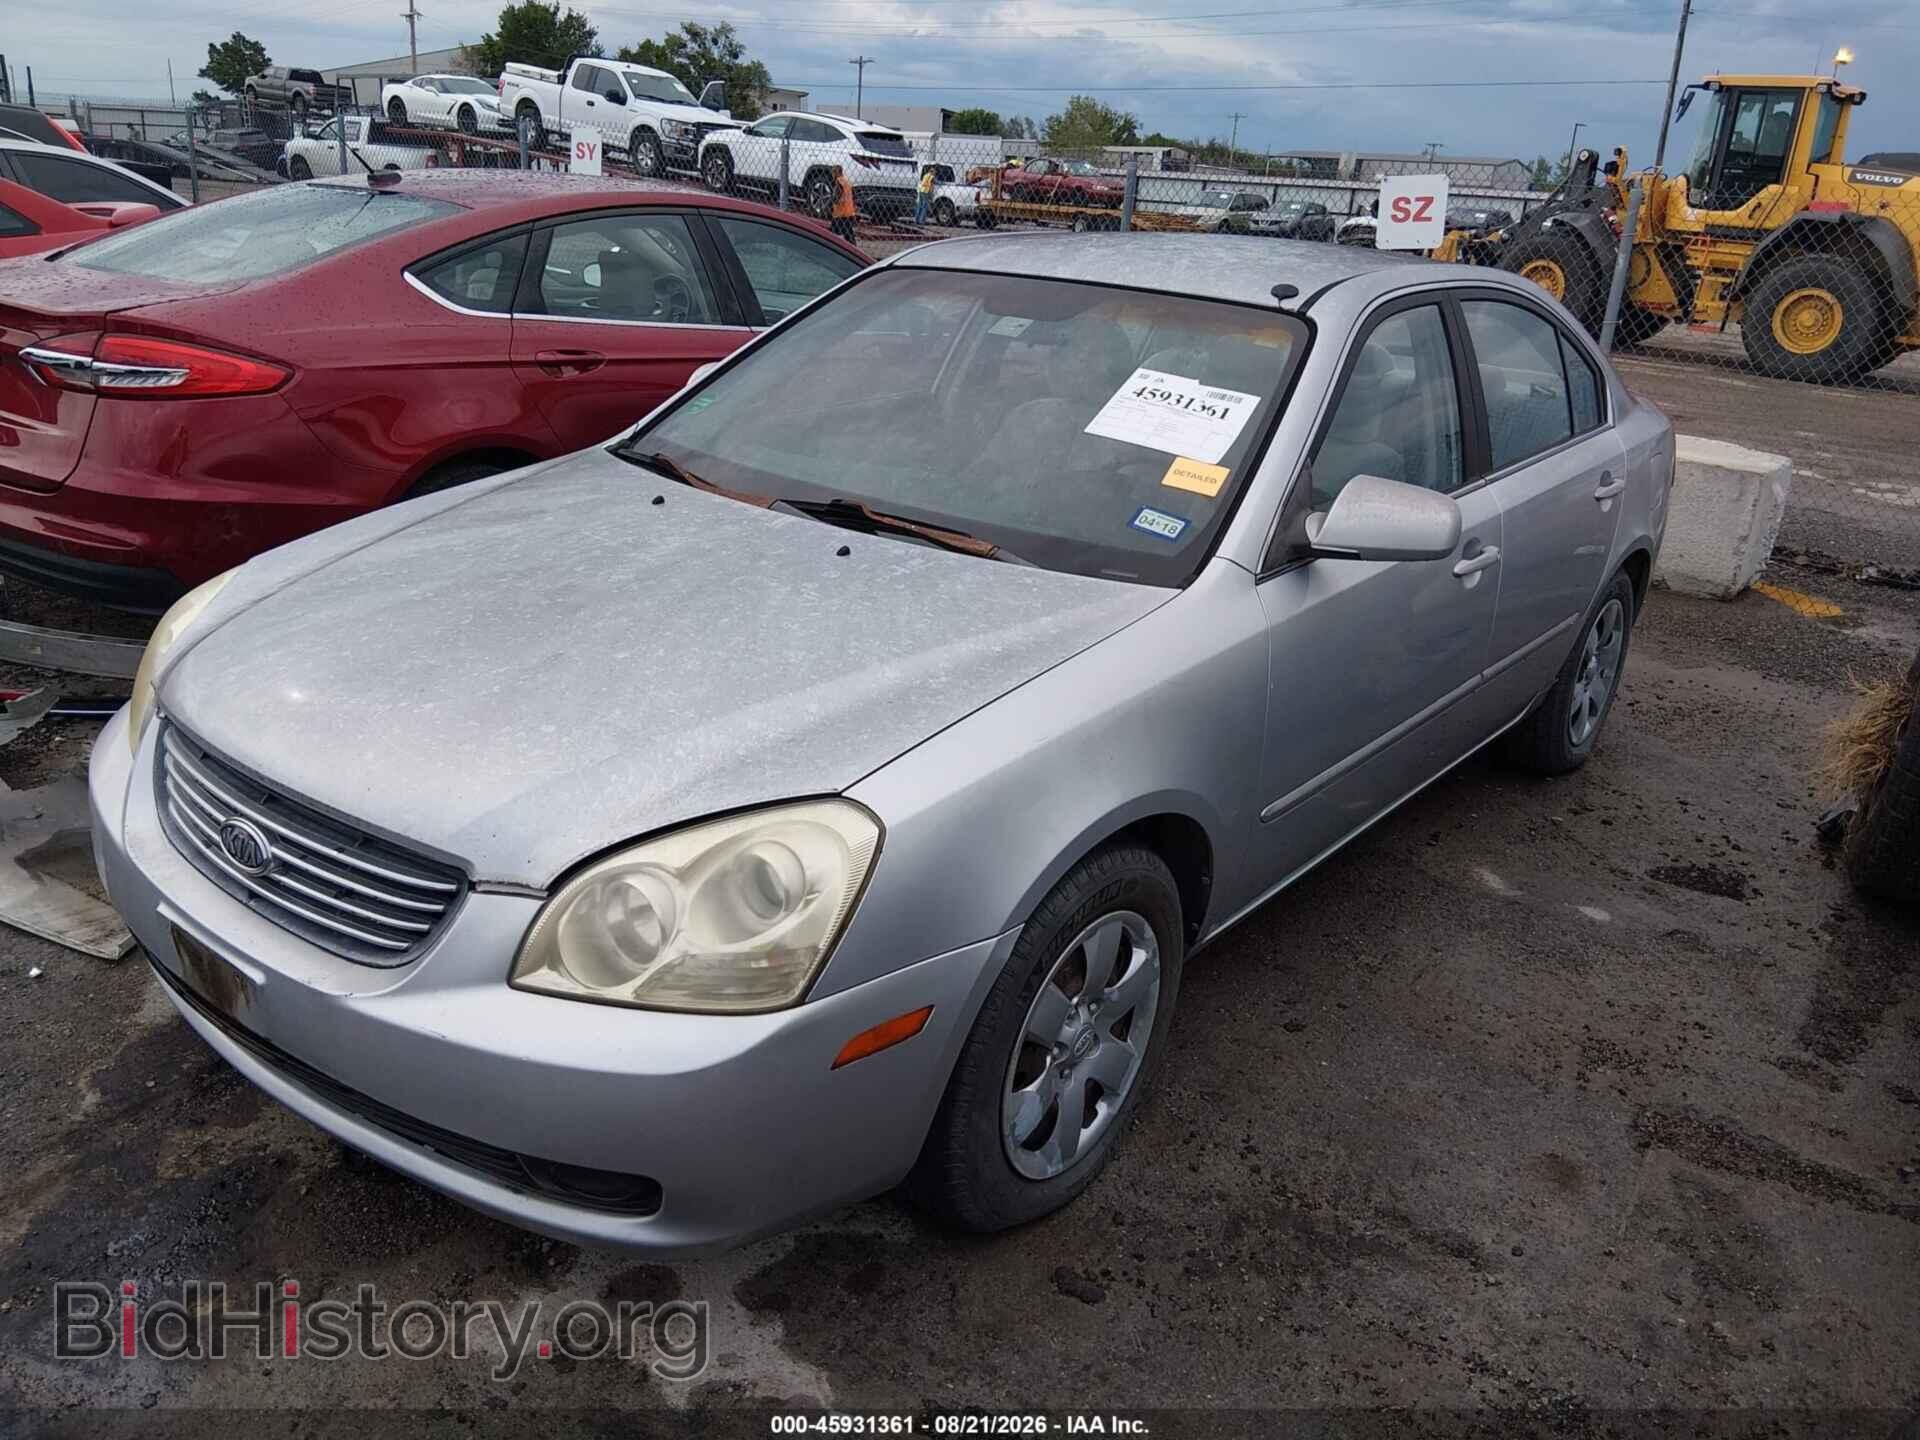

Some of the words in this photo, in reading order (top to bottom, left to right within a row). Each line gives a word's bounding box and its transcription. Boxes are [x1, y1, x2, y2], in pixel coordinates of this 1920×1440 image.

[576, 142, 597, 161] SY
[1855, 173, 1904, 185] VOLVO
[1391, 196, 1435, 223] SZ
[1173, 469, 1218, 485] DETAILED
[223, 826, 263, 868] KIA
